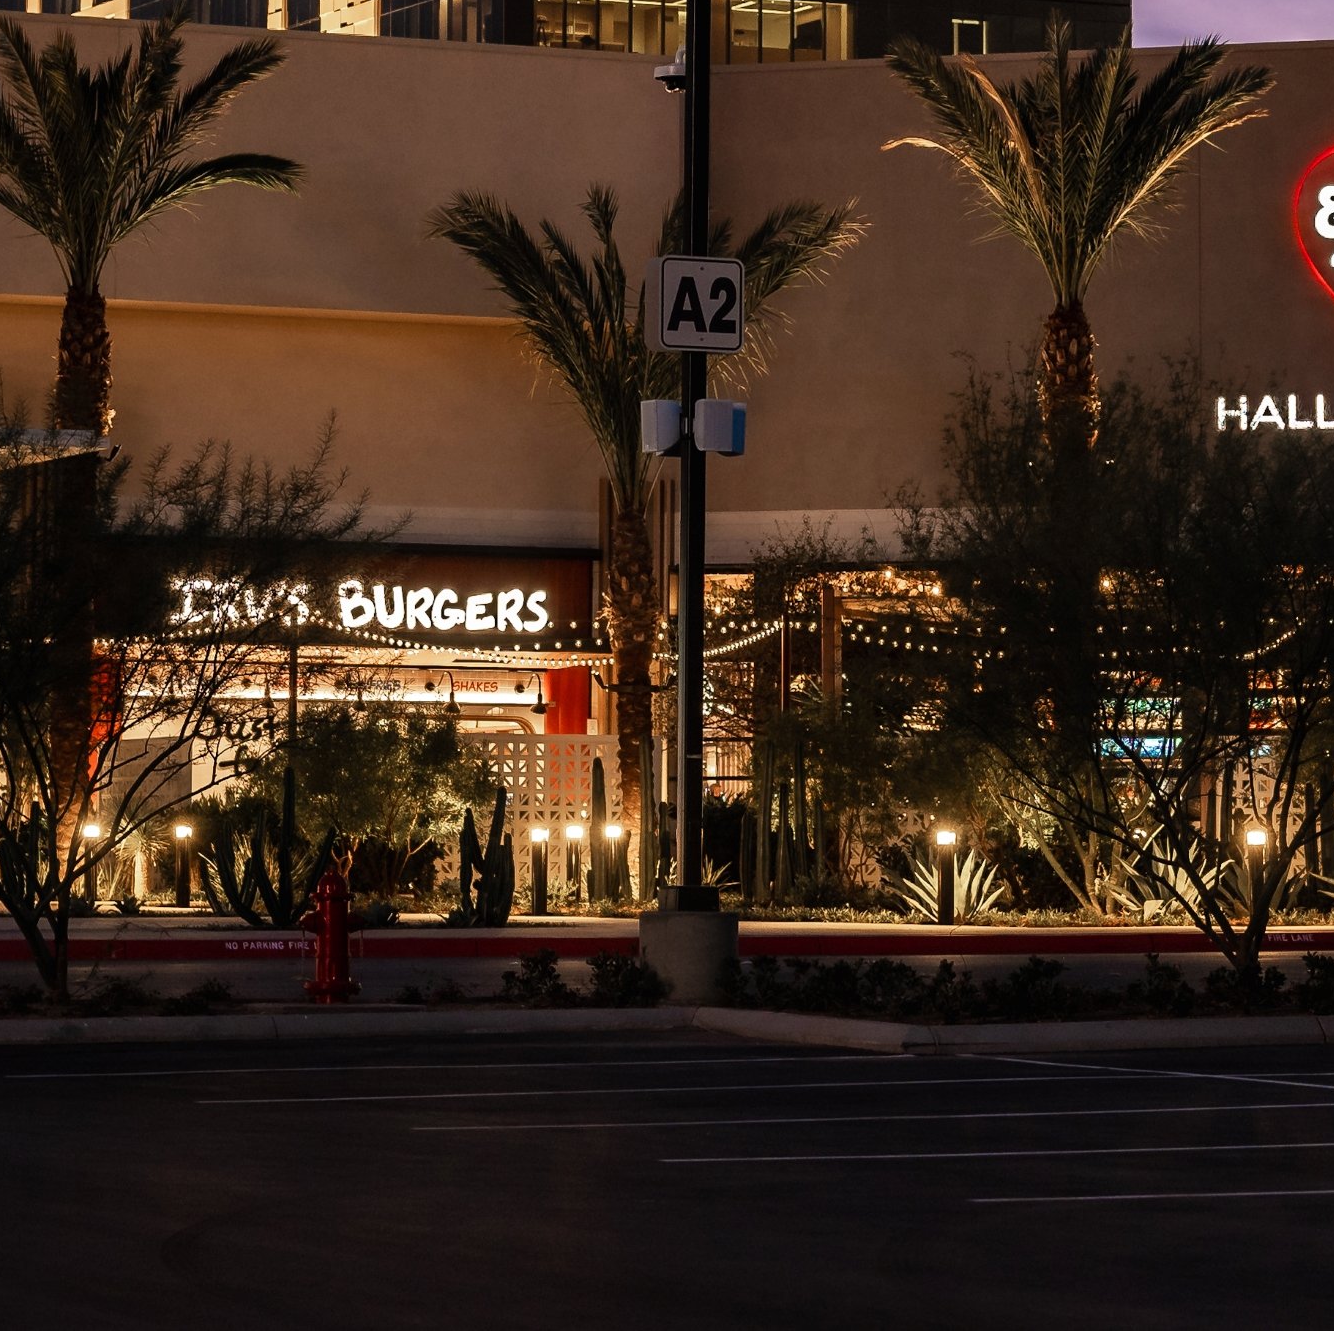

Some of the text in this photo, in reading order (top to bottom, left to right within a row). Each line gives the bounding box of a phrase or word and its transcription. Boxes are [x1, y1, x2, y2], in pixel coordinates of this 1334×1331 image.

[666, 276, 737, 334] A2
[337, 578, 550, 634] BURGERS
[452, 680, 499, 693] SHAKES
[224, 941, 238, 949] NO
[243, 941, 284, 950] PARKING
[289, 941, 309, 950] FIRE
